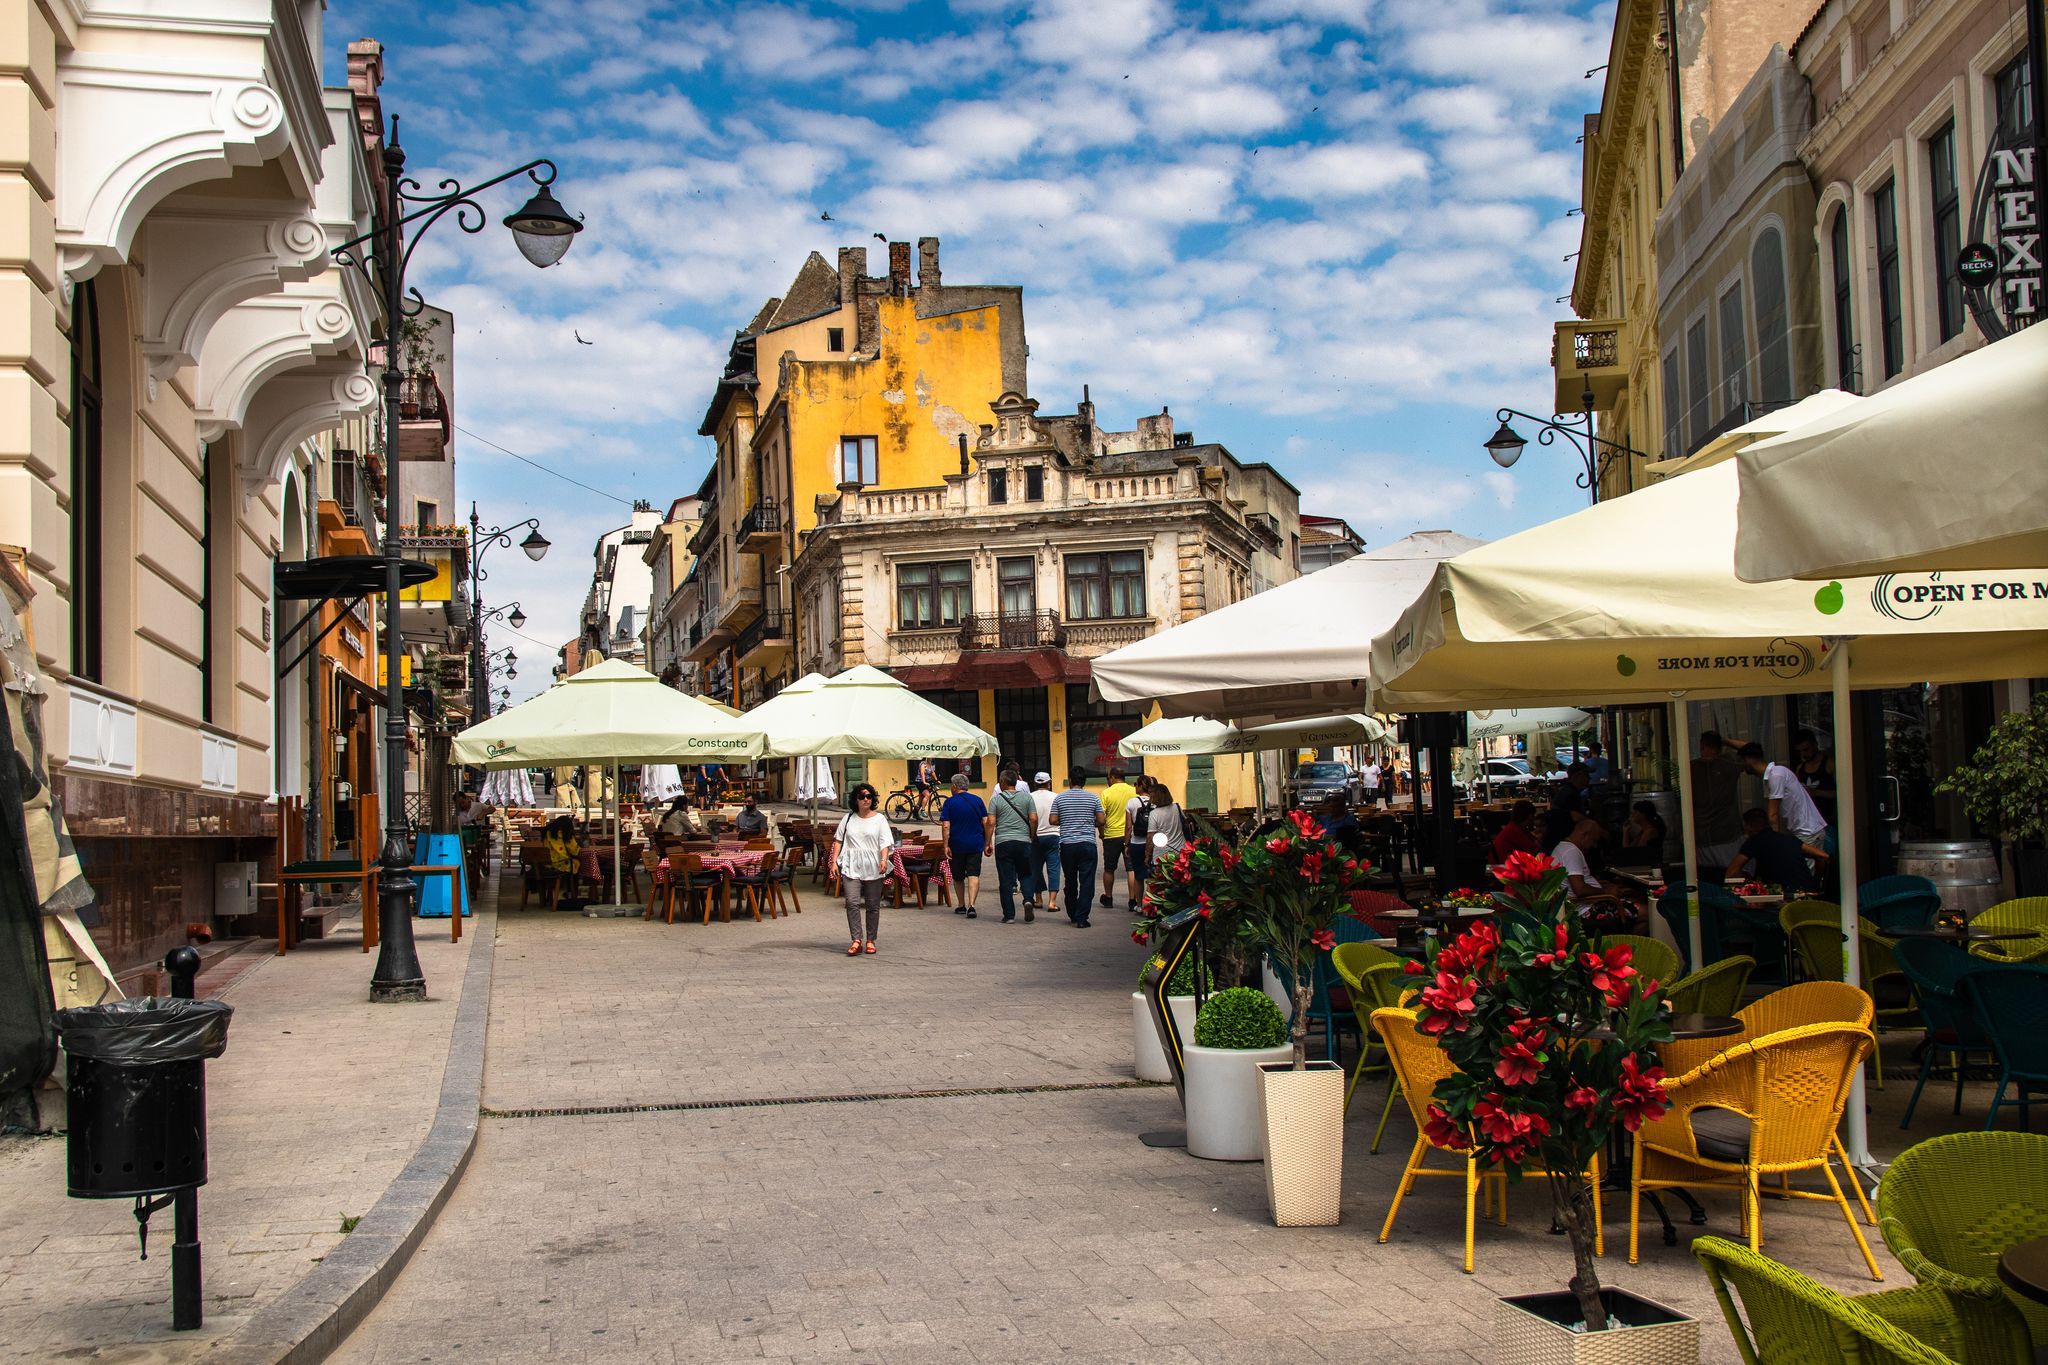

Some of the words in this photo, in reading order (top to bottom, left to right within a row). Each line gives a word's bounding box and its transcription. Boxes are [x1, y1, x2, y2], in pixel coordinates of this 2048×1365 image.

[1995, 147, 2042, 314] NEXT
[1961, 261, 1994, 270] BECK'S
[1893, 585, 1965, 603] OPEN
[1971, 582, 2028, 600] FOR
[1308, 731, 1349, 742] GUINNESS
[688, 737, 748, 748] Constanta
[906, 742, 958, 752] Constanta
[1141, 743, 1181, 752] GUINNESS
